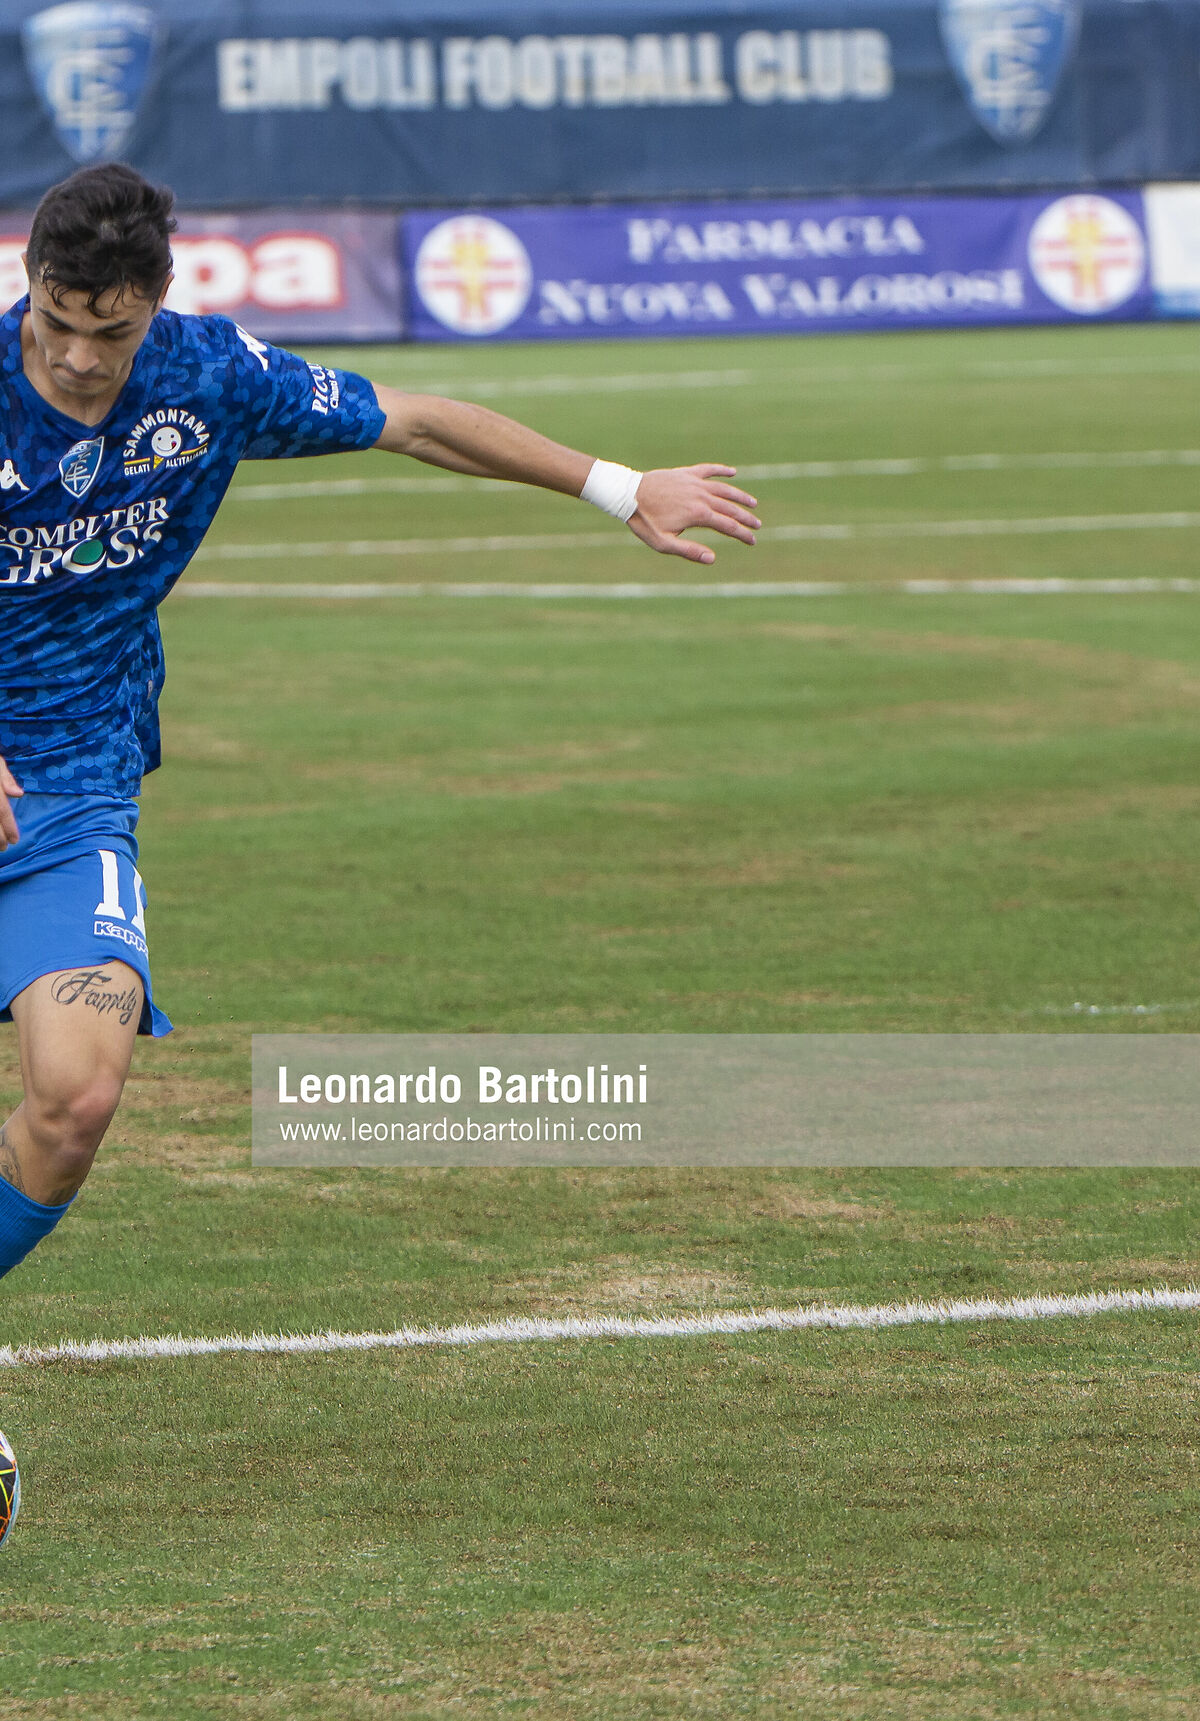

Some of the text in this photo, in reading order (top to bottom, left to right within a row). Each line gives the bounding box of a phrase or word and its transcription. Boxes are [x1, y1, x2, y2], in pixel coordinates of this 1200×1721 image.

[217, 30, 892, 112] EMPOLI FOOTBALL CLUB
[628, 216, 924, 264] FARMACIA
[539, 280, 734, 325] NUOVA
[123, 408, 210, 458] SAMMONTANA
[124, 464, 150, 476] GELATI
[93, 921, 149, 954] Kapp
